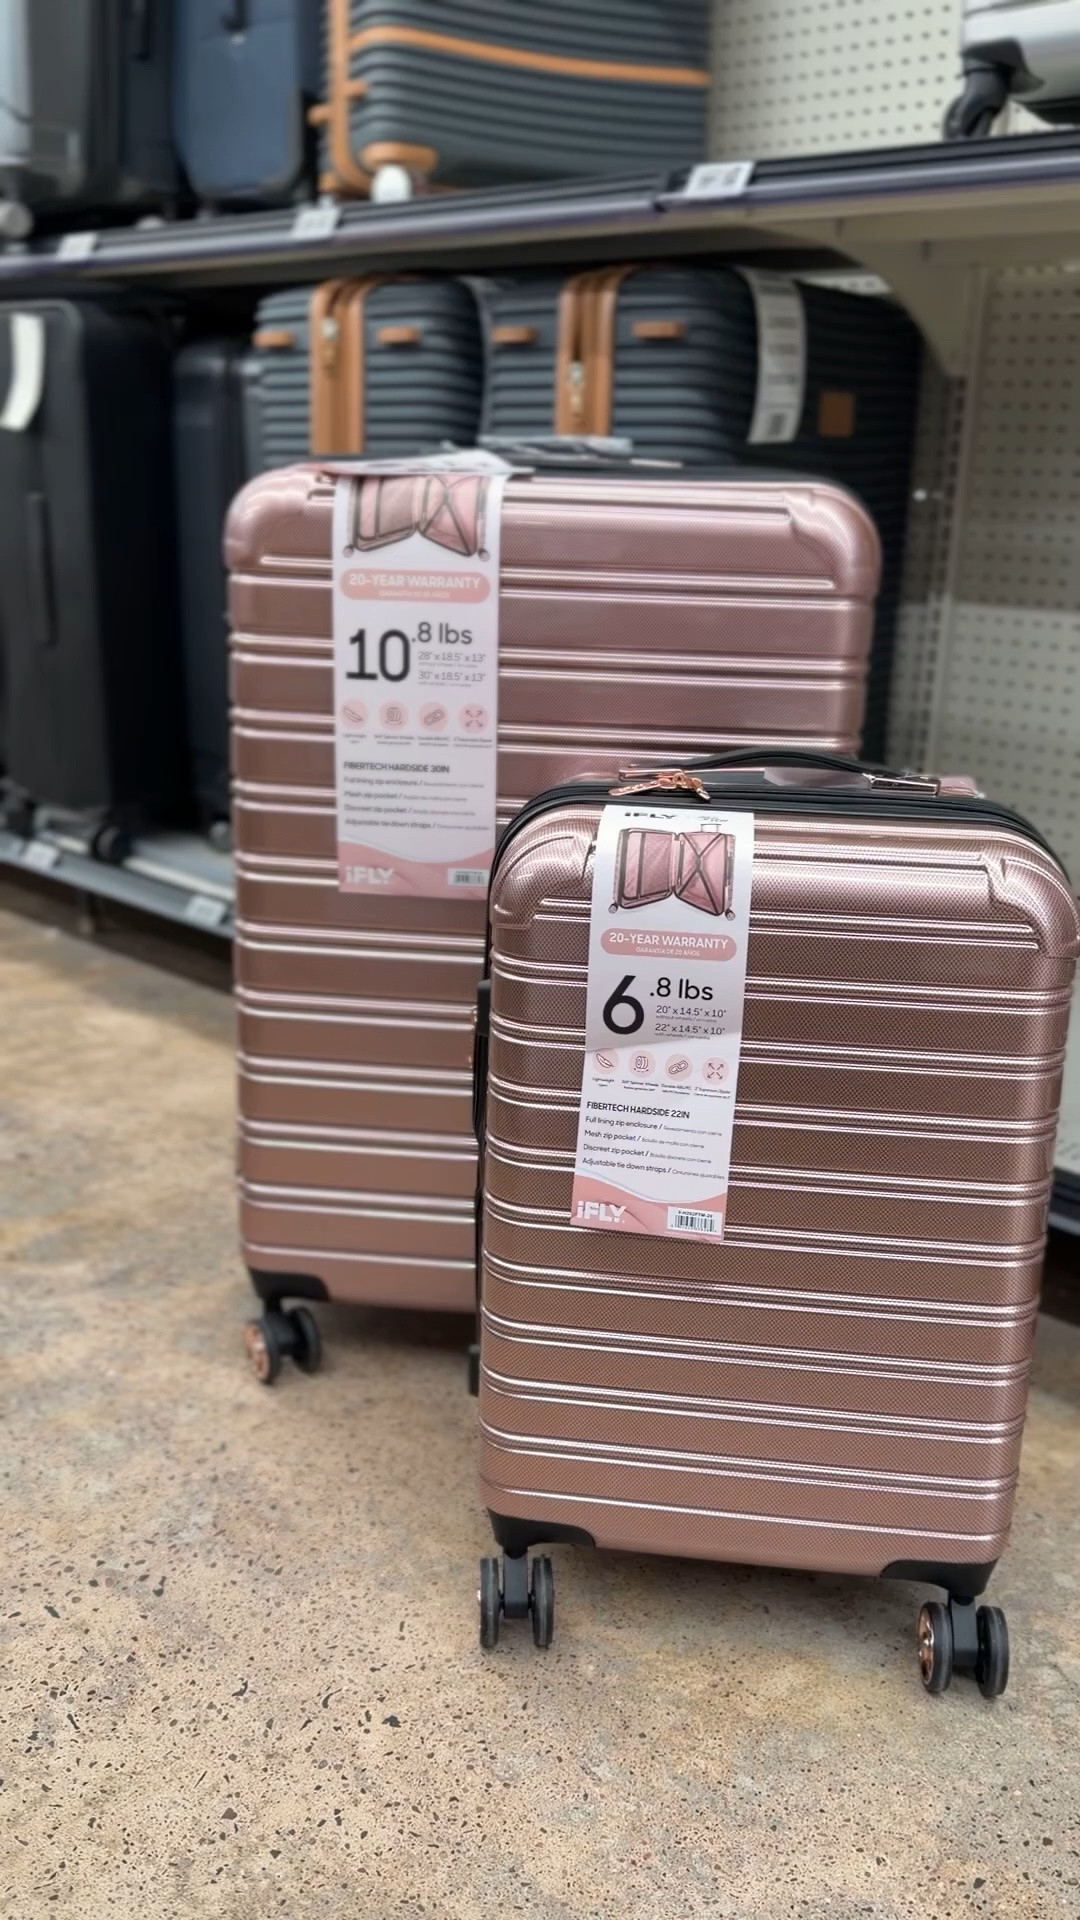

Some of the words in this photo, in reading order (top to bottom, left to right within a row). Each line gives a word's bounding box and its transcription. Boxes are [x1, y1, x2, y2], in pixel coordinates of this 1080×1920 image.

[349, 573, 405, 586] 20-YEAR
[407, 575, 481, 589] WARRANTY
[345, 628, 411, 682] 10
[439, 623, 473, 645] lbs
[343, 761, 388, 771] FIBERTECH
[388, 763, 429, 773] HARDSIDE
[609, 932, 659, 946] 20-YEAR
[661, 935, 728, 949] WARRANTY
[602, 975, 645, 1035] 6
[678, 978, 714, 1001] lbs
[586, 1101, 629, 1112] FIBERTECH
[630, 1105, 670, 1117] HARDSIDE
[671, 1109, 690, 1119] 22IN
[585, 1115, 597, 1123] Full
[597, 1117, 614, 1126] lining
[615, 1119, 625, 1127] zip
[625, 1121, 658, 1129] enclosure
[603, 1132, 613, 1140] zip
[583, 1143, 610, 1152] Discreet
[621, 1149, 645, 1157] pocket
[582, 1157, 616, 1167] Adjustable
[645, 1165, 667, 1175] straps
[575, 1200, 627, 1224] iFLY
